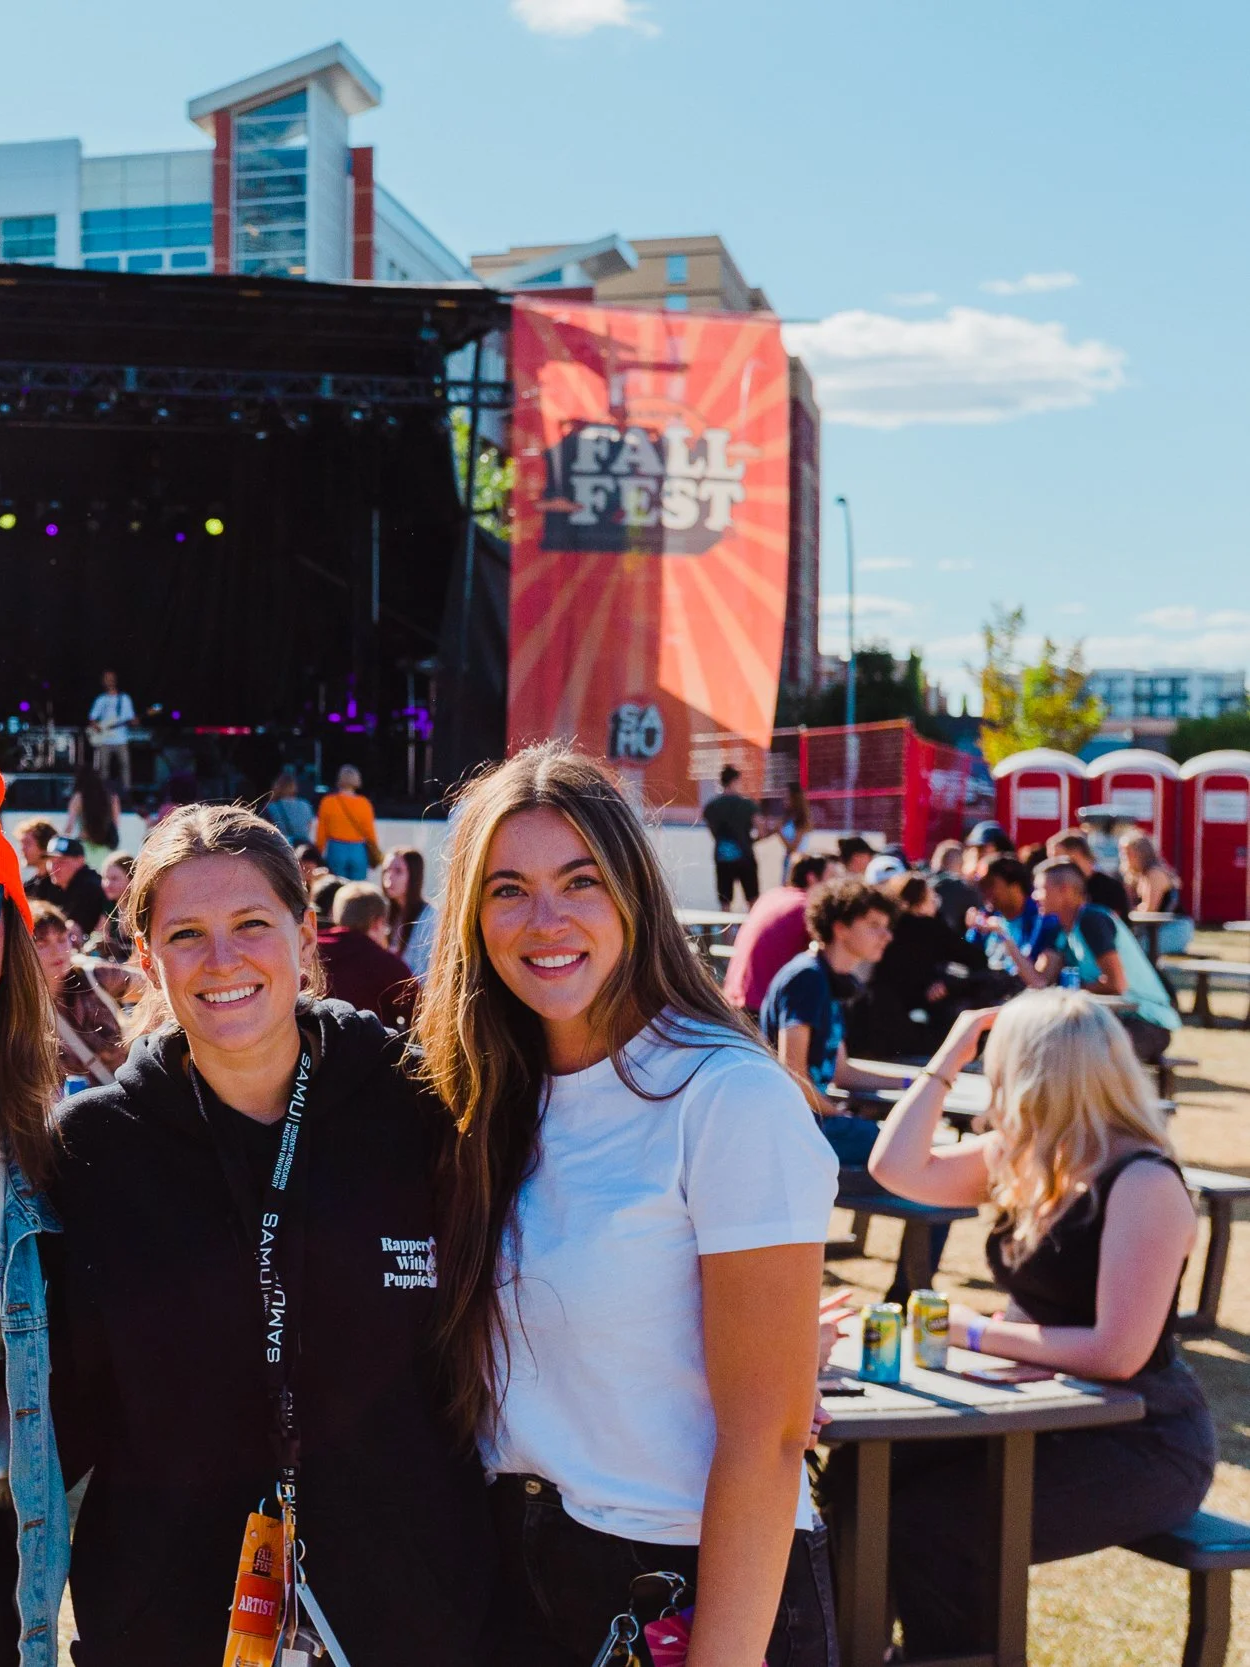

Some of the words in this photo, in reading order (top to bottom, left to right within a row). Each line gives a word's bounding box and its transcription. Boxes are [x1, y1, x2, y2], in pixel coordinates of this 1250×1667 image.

[571, 425, 745, 479] FALL
[568, 477, 746, 531] FEST
[288, 1052, 311, 1118] SAMU
[280, 1122, 292, 1152] MACEWAN
[271, 1152, 286, 1189] UNIVERSITY
[278, 1152, 293, 1191] ASSOCIATION
[259, 1212, 279, 1284] SAMU
[396, 1255, 426, 1270] With
[266, 1289, 286, 1363] SAMU
[254, 1559, 273, 1573] FEST
[256, 1547, 273, 1561] FALL
[237, 1594, 275, 1616] ARTIST
